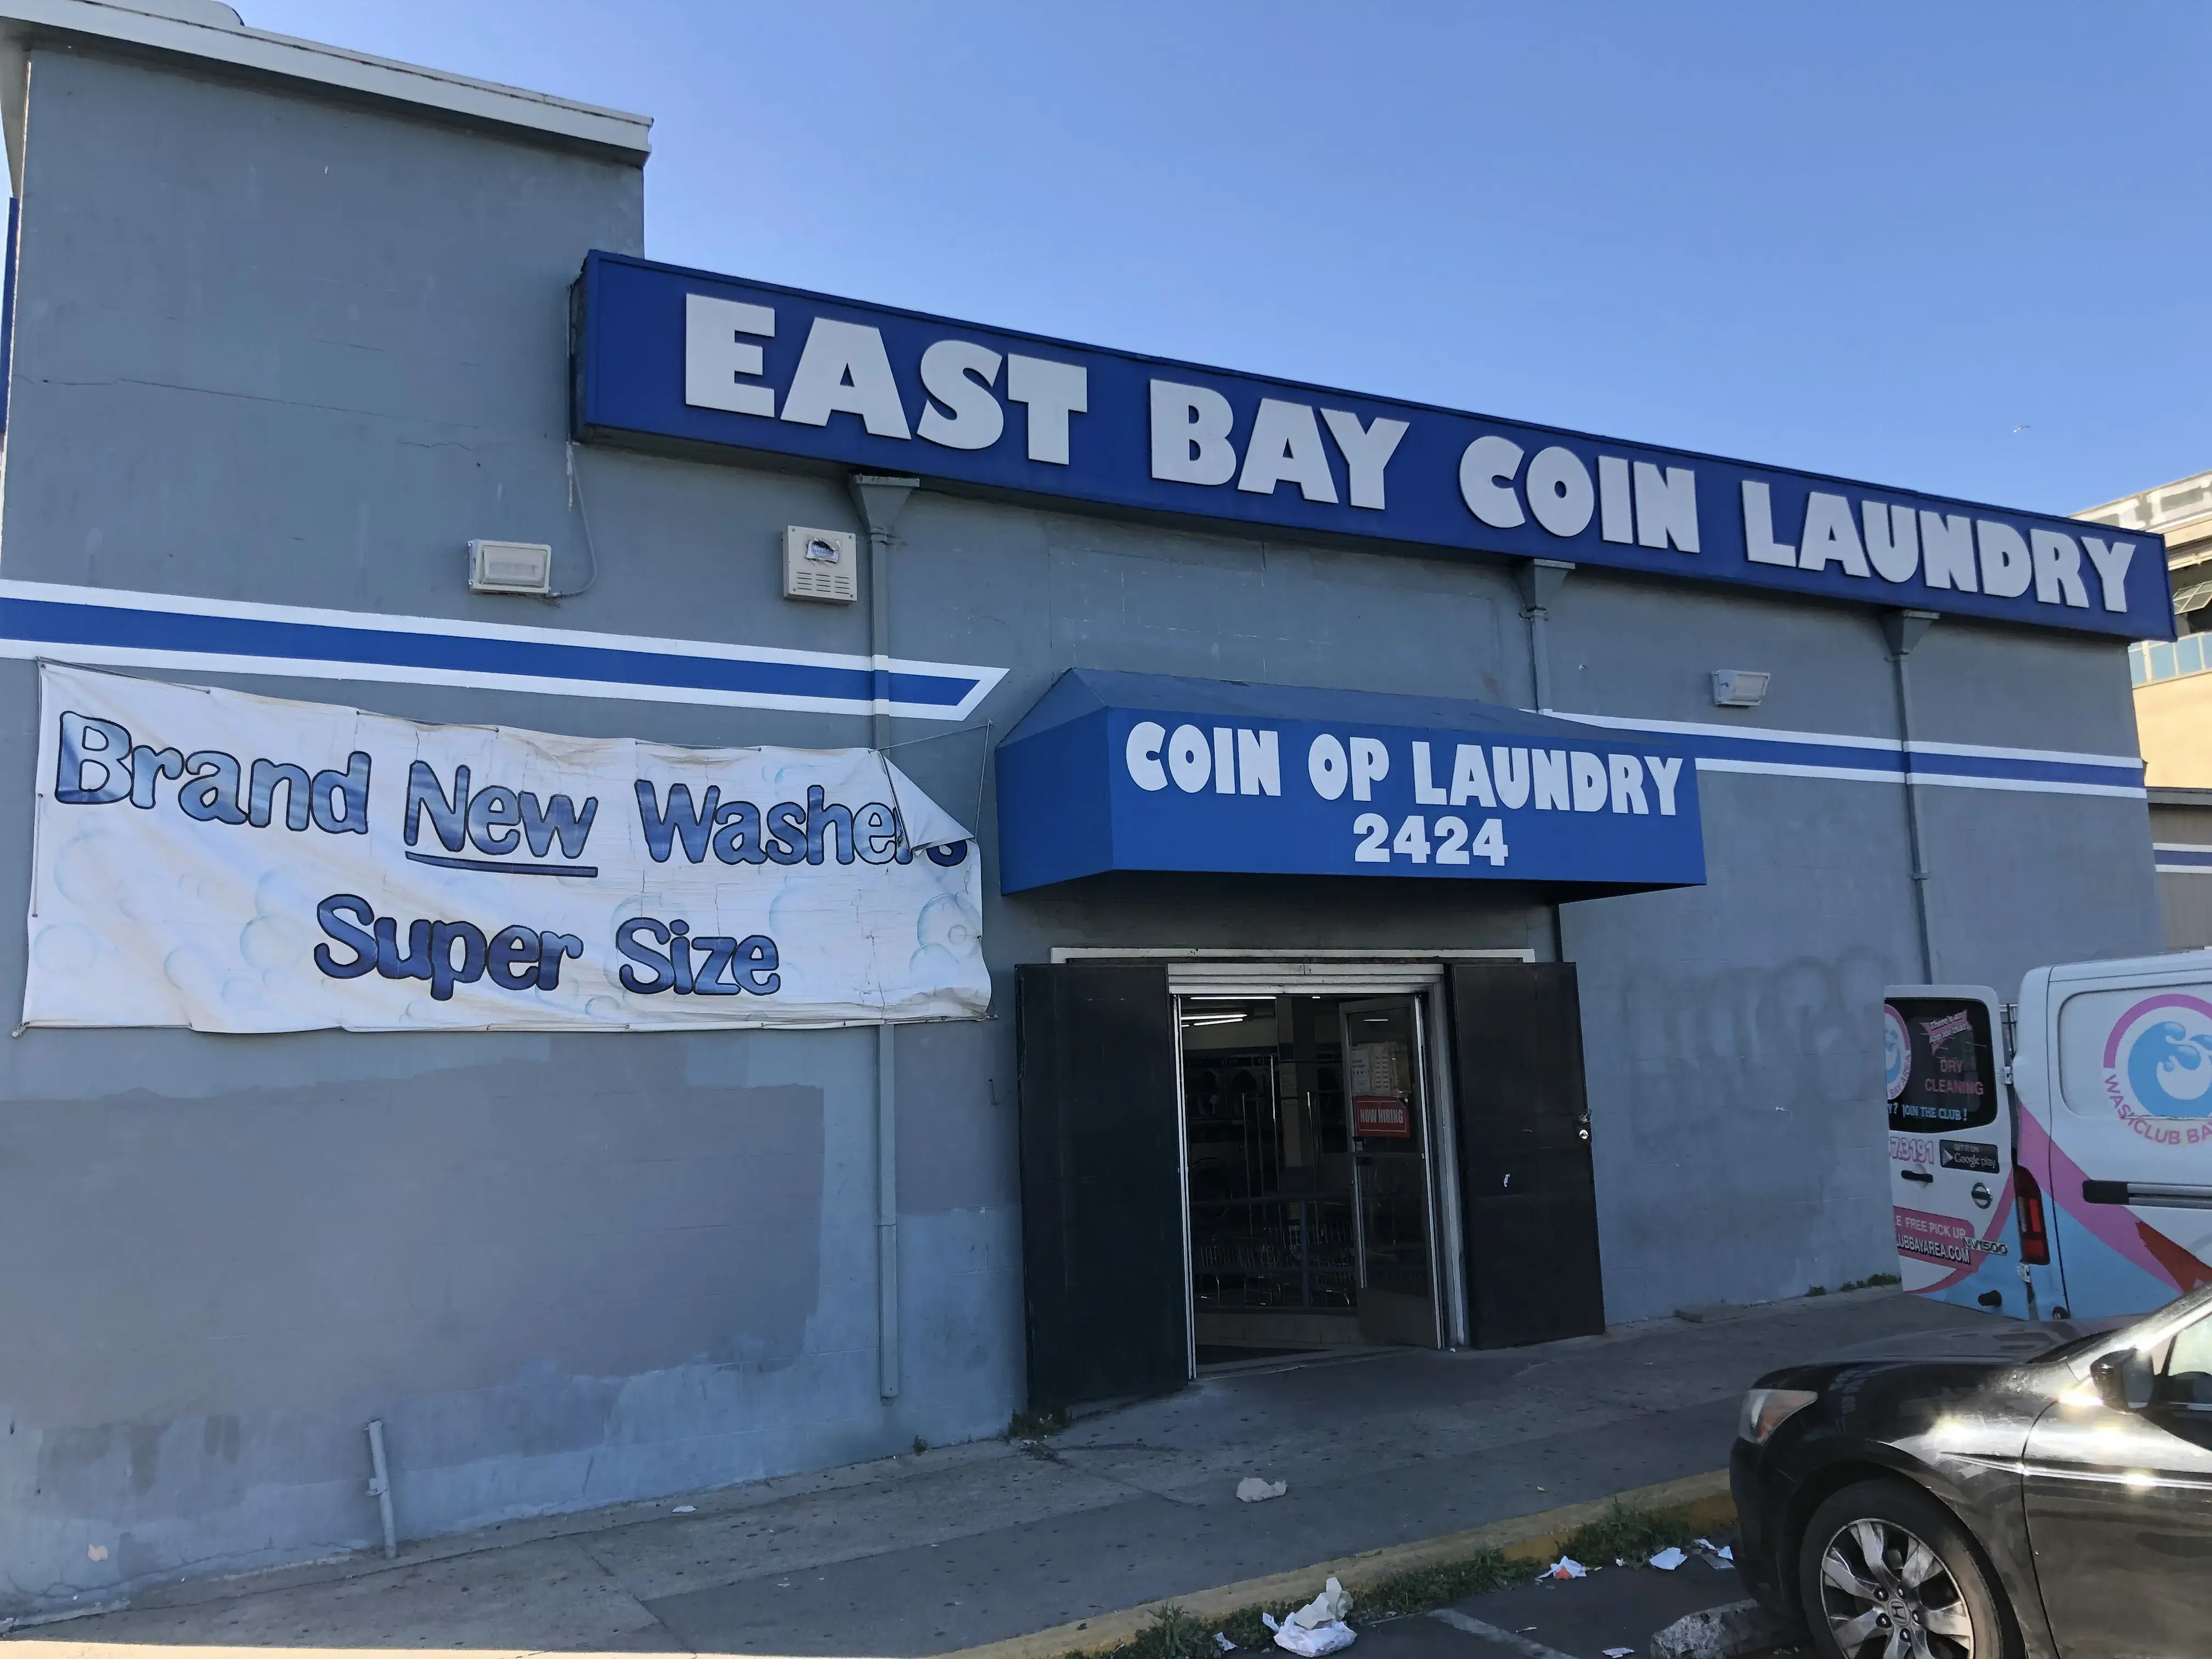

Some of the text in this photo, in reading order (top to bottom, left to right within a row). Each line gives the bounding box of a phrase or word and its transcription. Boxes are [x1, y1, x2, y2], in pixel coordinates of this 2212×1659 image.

[685, 292, 2136, 613] EAST BAY COIN LAUNDRY
[1125, 721, 1683, 816] COIN OP LAUNDRY
[54, 710, 372, 834] Brand
[404, 759, 599, 860] New
[1352, 812, 1509, 867] 2424
[313, 893, 781, 1001] Super Size
[1940, 1059, 1963, 1073] DRY
[1925, 1077, 1984, 1096] CLEANING
[1359, 1108, 1404, 1124] NOW HIRING
[1902, 1104, 1918, 1118] JOIN
[1920, 1106, 1937, 1118] THE
[1954, 1153, 1995, 1169] Google play
[1905, 1217, 1928, 1232] FREE
[1929, 1222, 1950, 1237] PICK
[1953, 1227, 1967, 1240] UP
